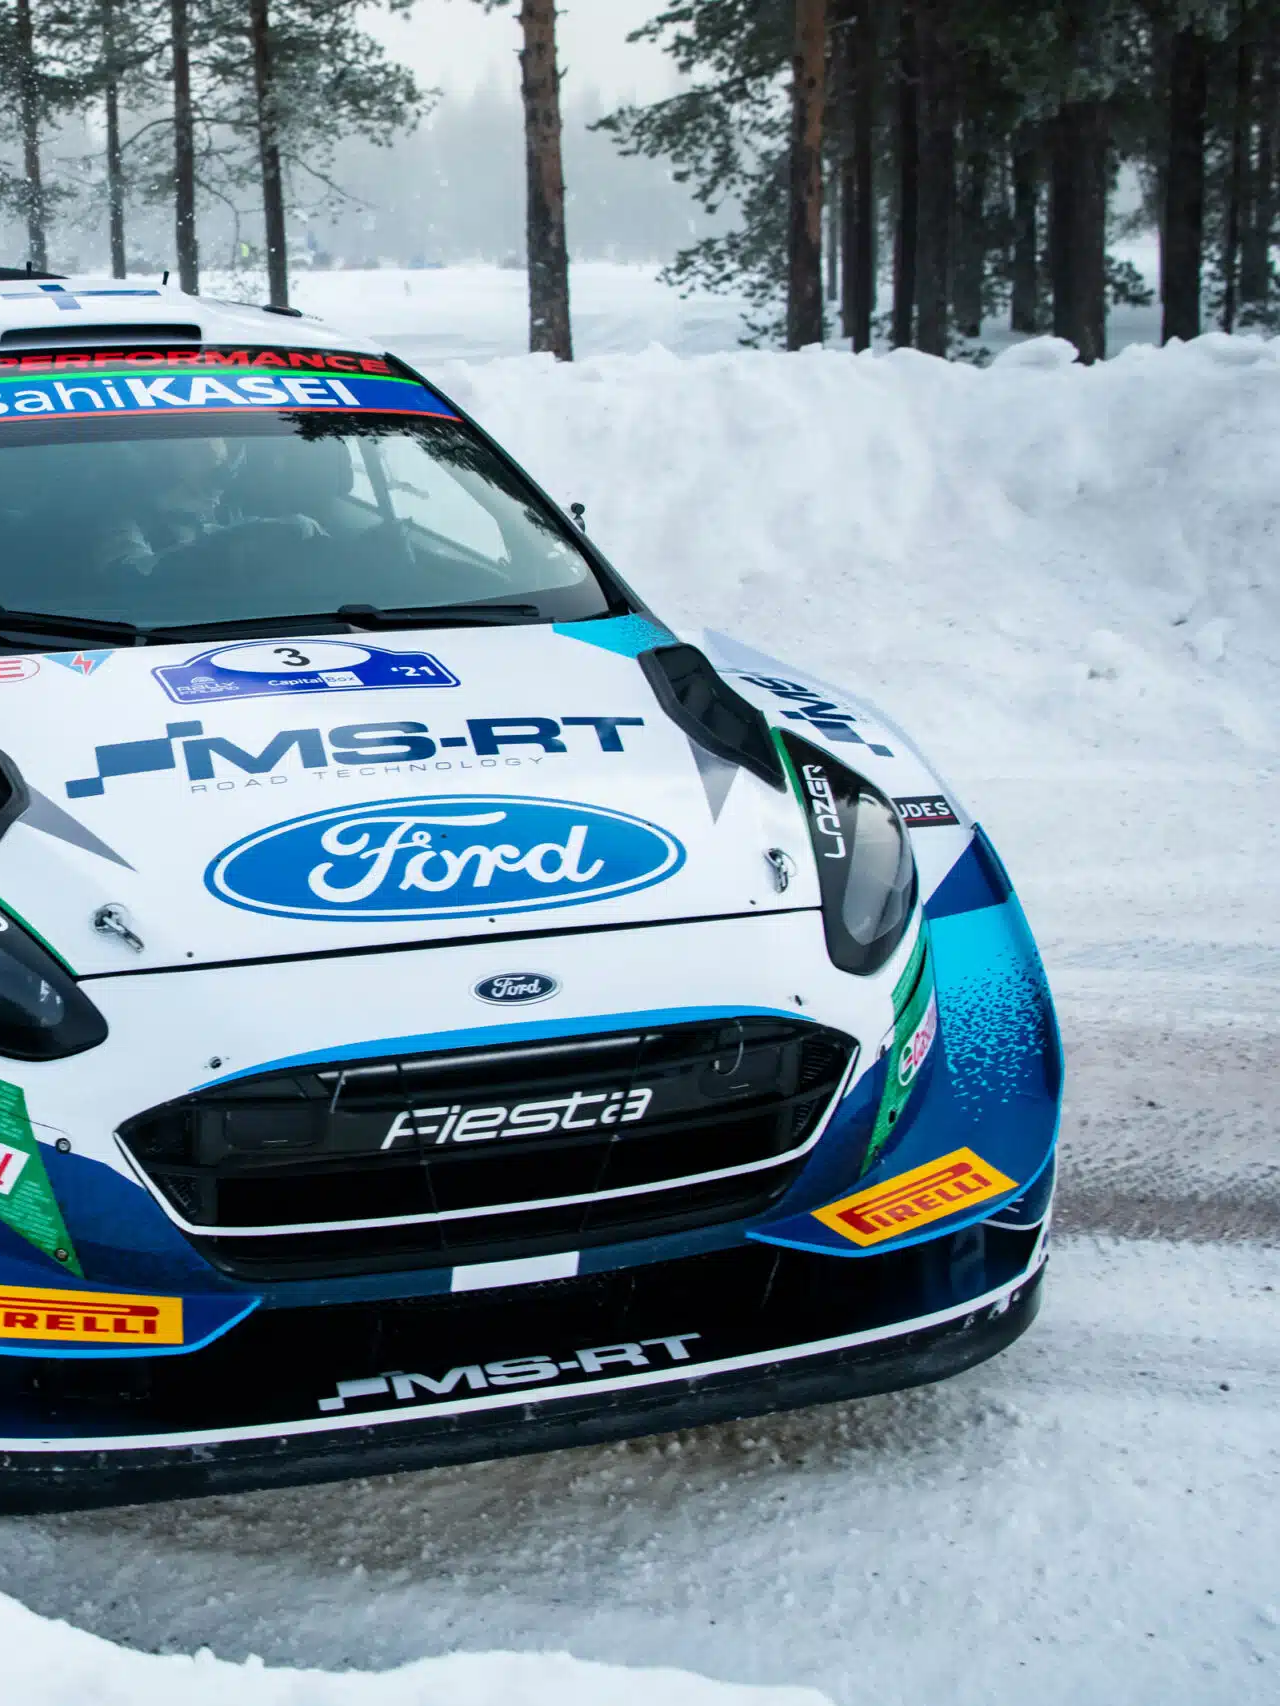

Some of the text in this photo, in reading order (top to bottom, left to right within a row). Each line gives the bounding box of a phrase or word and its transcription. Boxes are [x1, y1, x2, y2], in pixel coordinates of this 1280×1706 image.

[273, 647, 311, 667] 3
[182, 716, 645, 781] MS-RT
[191, 755, 545, 794] ROAD TECHNOLOGY
[802, 764, 847, 859] LAZER
[898, 801, 951, 818] UDES
[308, 811, 605, 903] Ford
[491, 976, 542, 998] Ford
[380, 1088, 653, 1150] Fiesta
[835, 1162, 993, 1235] PIRELLI
[390, 1332, 702, 1401] MS-RT
